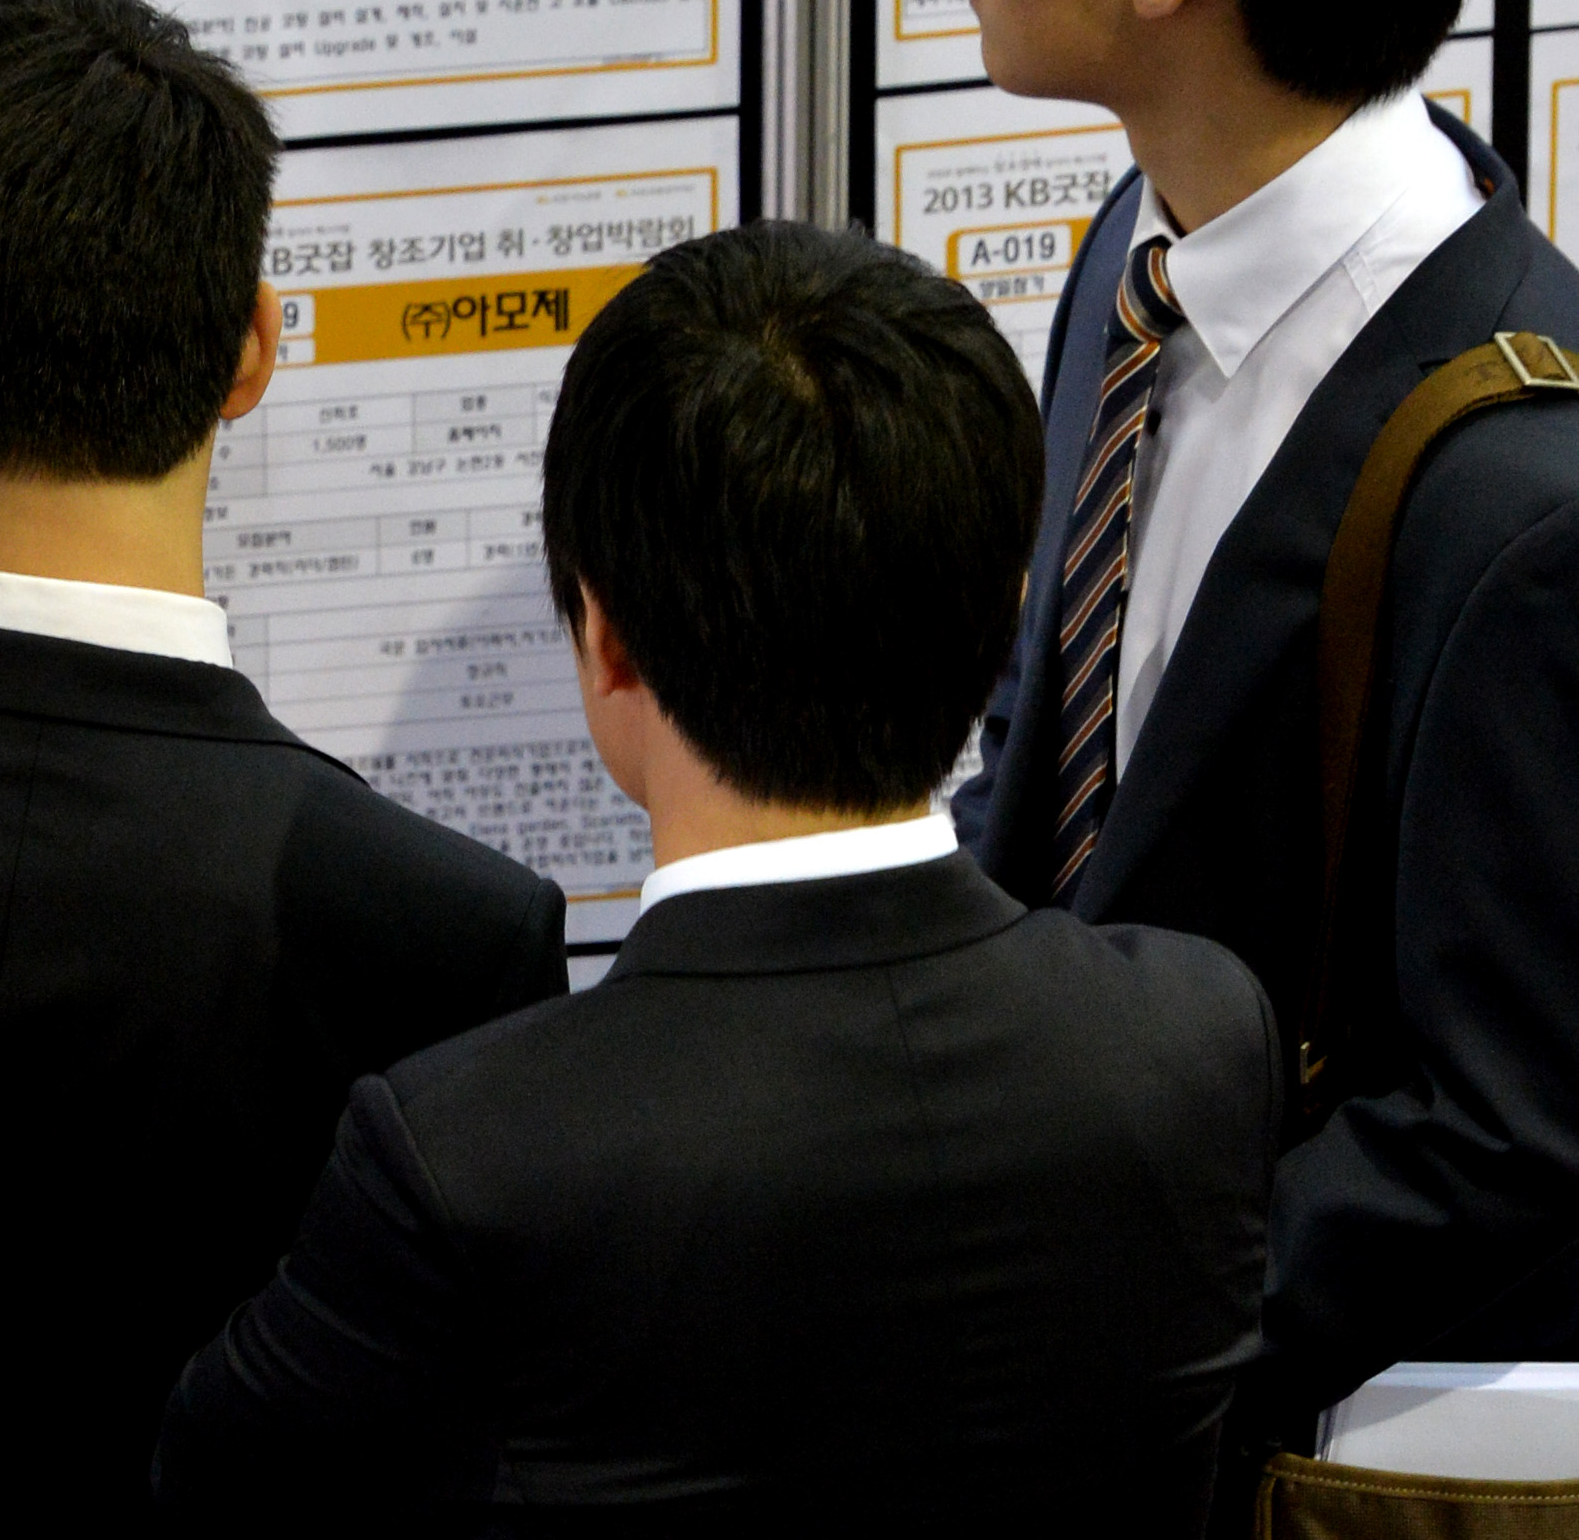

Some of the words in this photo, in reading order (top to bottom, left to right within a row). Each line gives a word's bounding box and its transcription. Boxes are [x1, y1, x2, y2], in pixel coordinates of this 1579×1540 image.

[924, 183, 994, 213] 2013
[1004, 171, 1112, 208] KB굿잡
[368, 232, 488, 272] 창조기업
[972, 232, 1056, 266] A-019
[401, 287, 570, 341] (주)아모제
